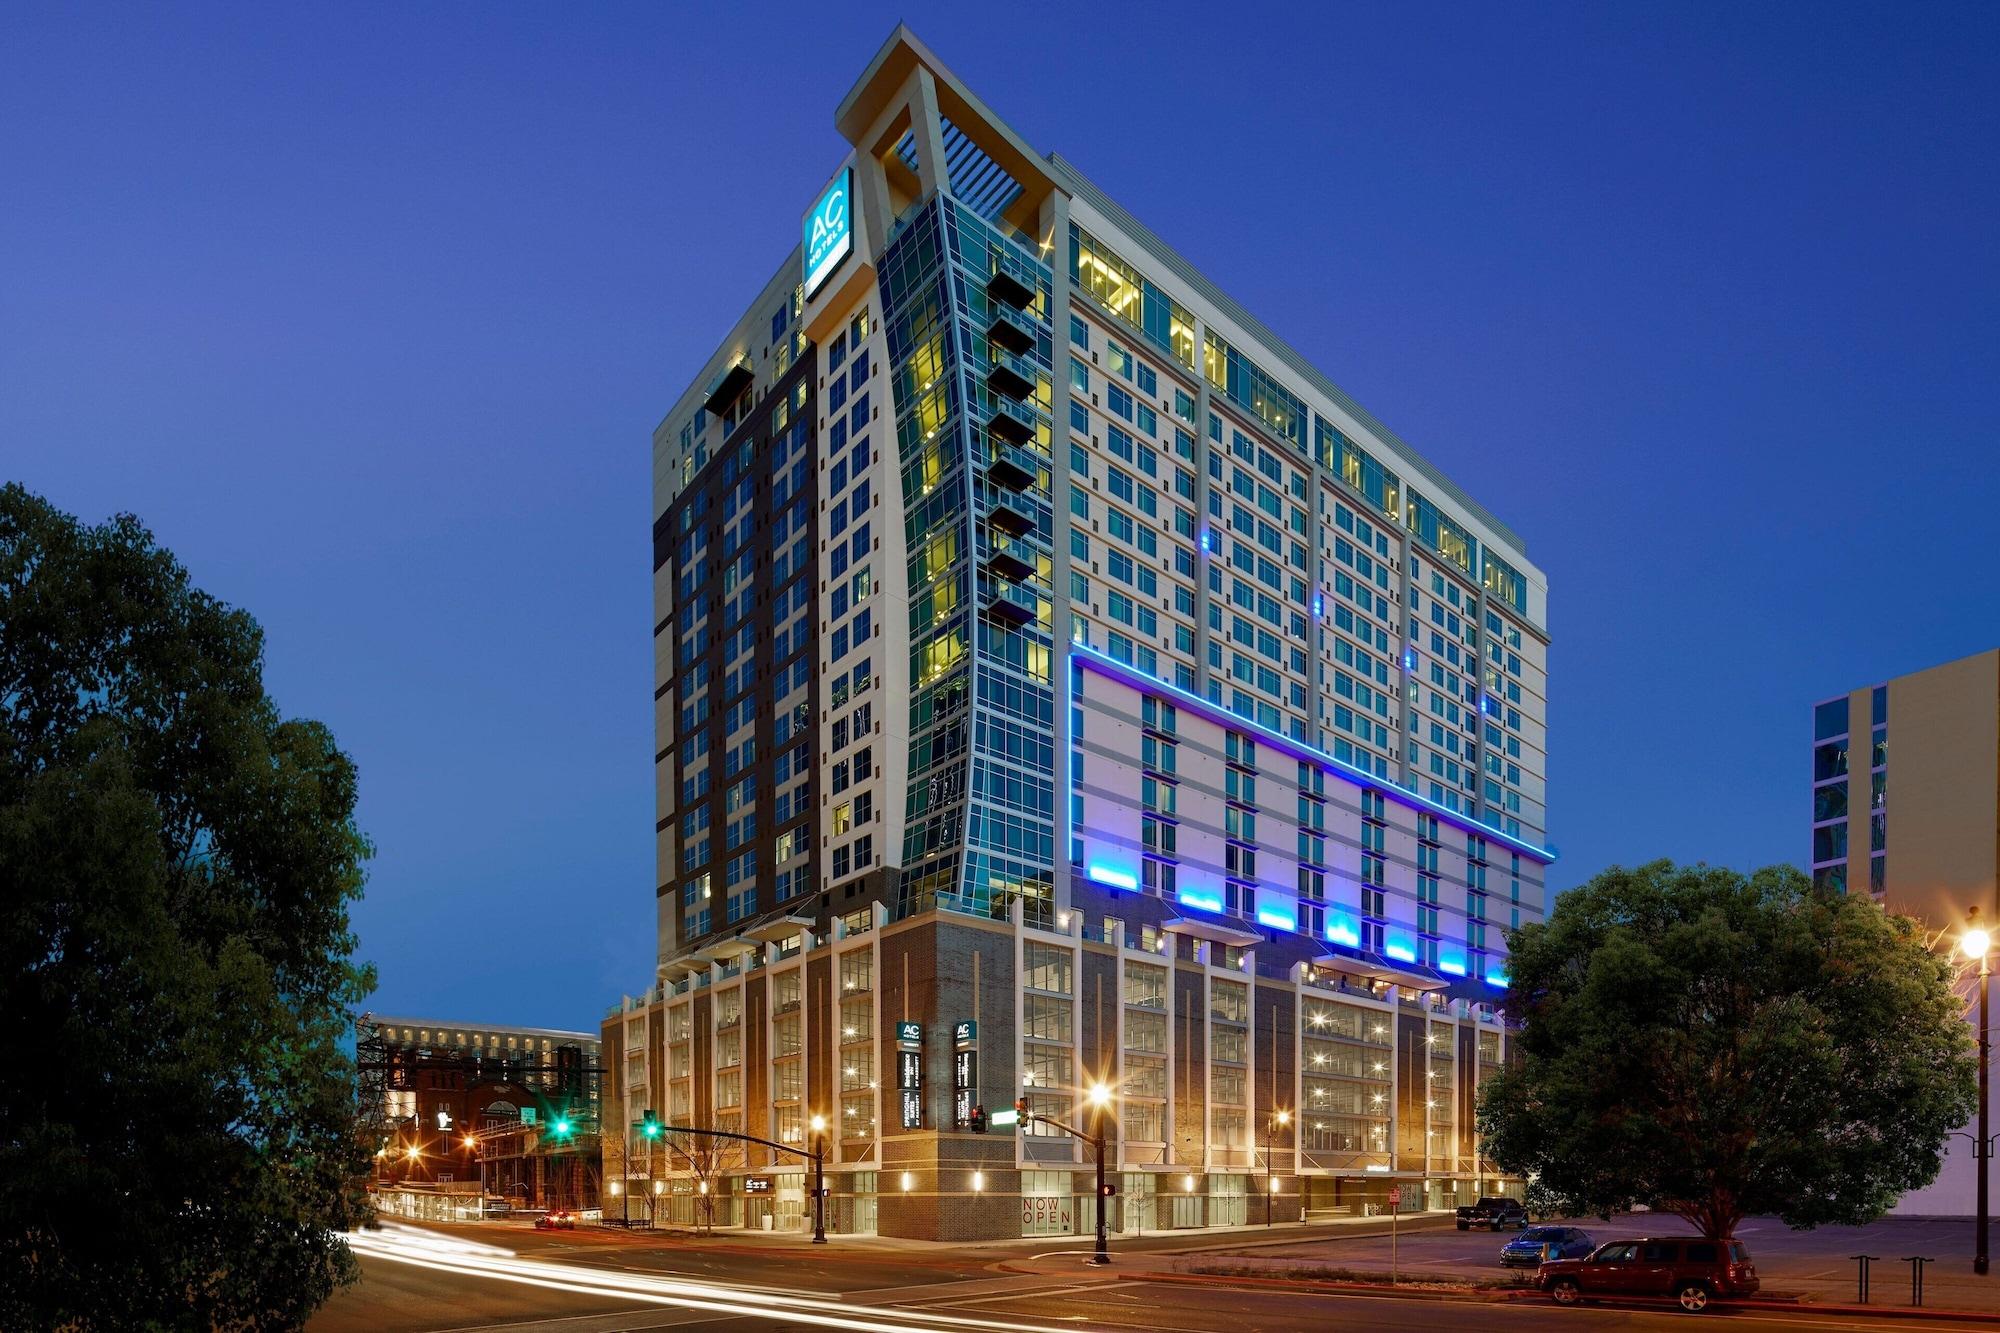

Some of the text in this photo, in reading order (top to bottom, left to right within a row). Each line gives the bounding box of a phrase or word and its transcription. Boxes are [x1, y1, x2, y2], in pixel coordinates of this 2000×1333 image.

[810, 190, 843, 254] AC
[809, 221, 844, 268] HOTELS
[904, 1024, 919, 1035] AC
[957, 1024, 969, 1034] AC
[1023, 1198, 1059, 1211] NOW
[1023, 1211, 1070, 1224] OPEN
